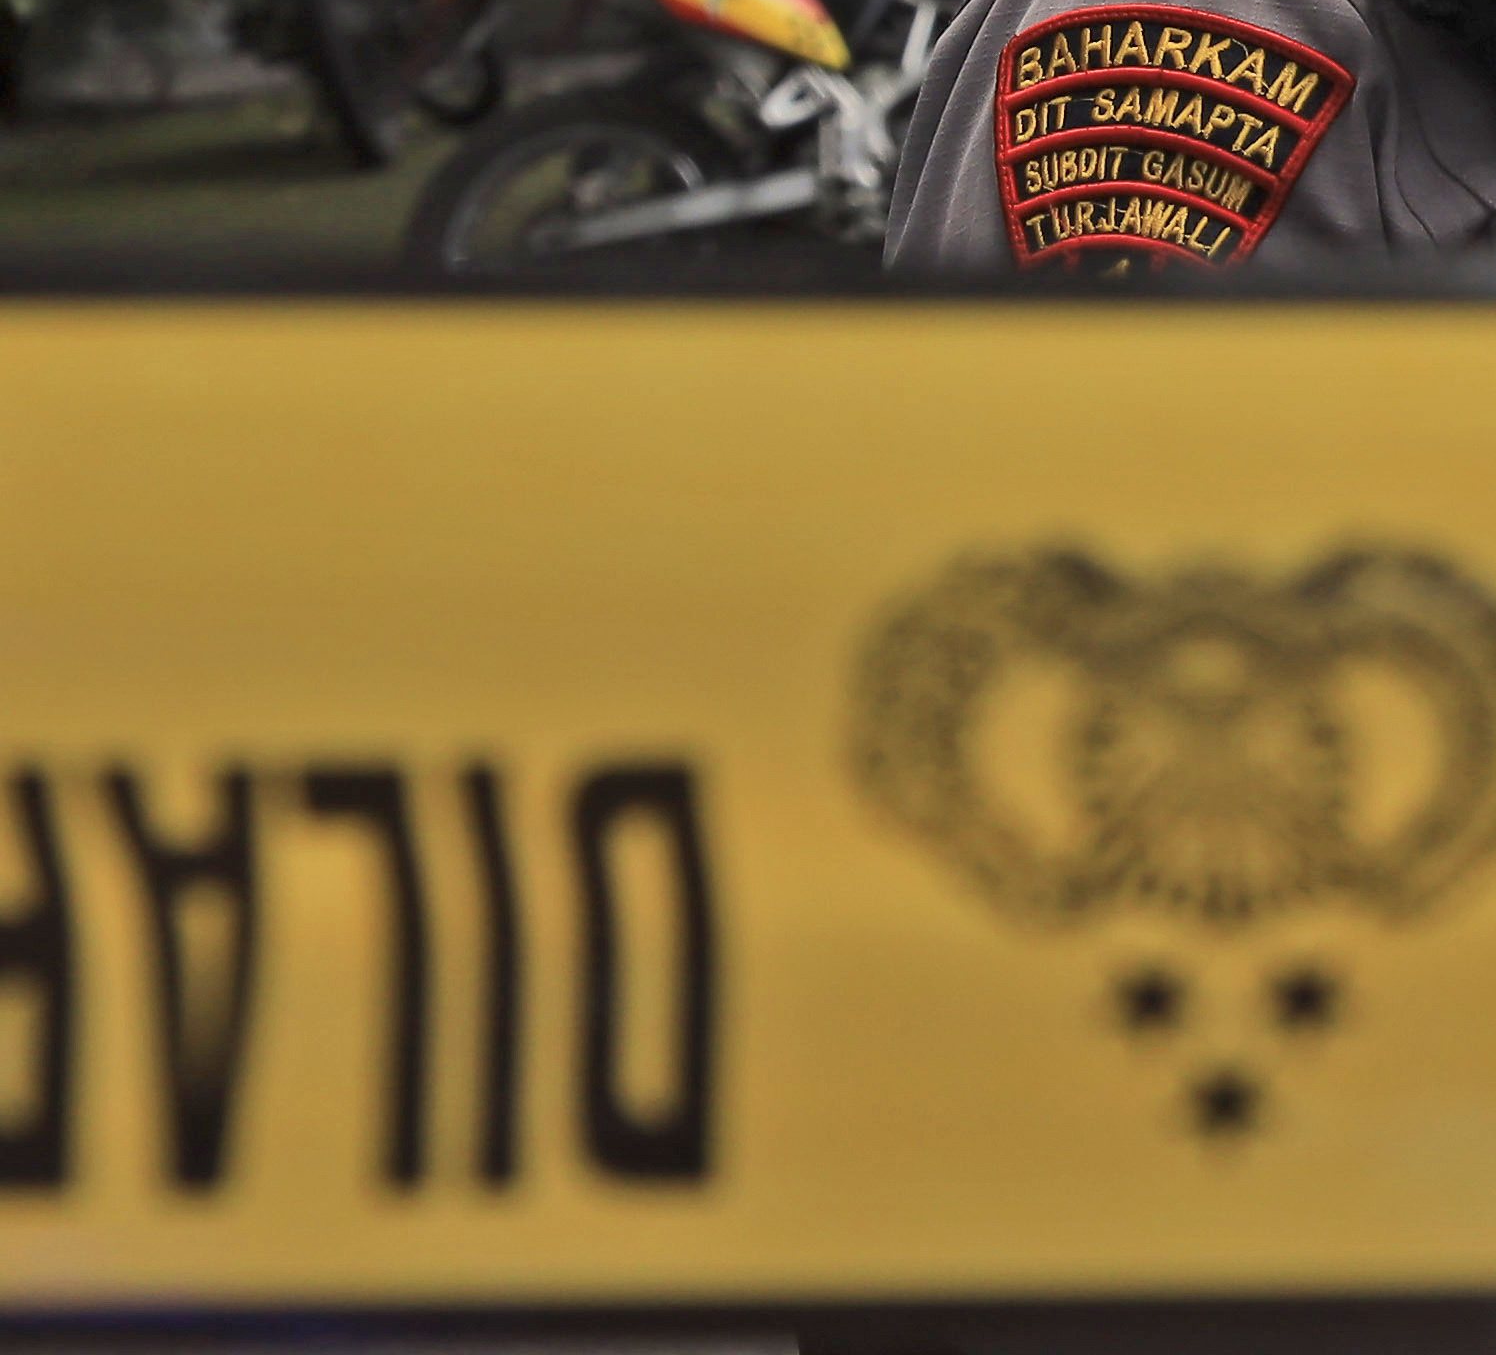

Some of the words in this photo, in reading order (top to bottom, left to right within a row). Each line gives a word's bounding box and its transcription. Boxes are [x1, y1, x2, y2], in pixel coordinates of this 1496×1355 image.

[1016, 20, 1319, 114] BAHARKAM
[1015, 94, 1072, 143] DIT
[1091, 86, 1281, 168] SAMAPTA
[1025, 146, 1128, 193] SUBDIT
[1142, 150, 1252, 213] GASUM
[1026, 196, 1232, 258] TURJAWALI
